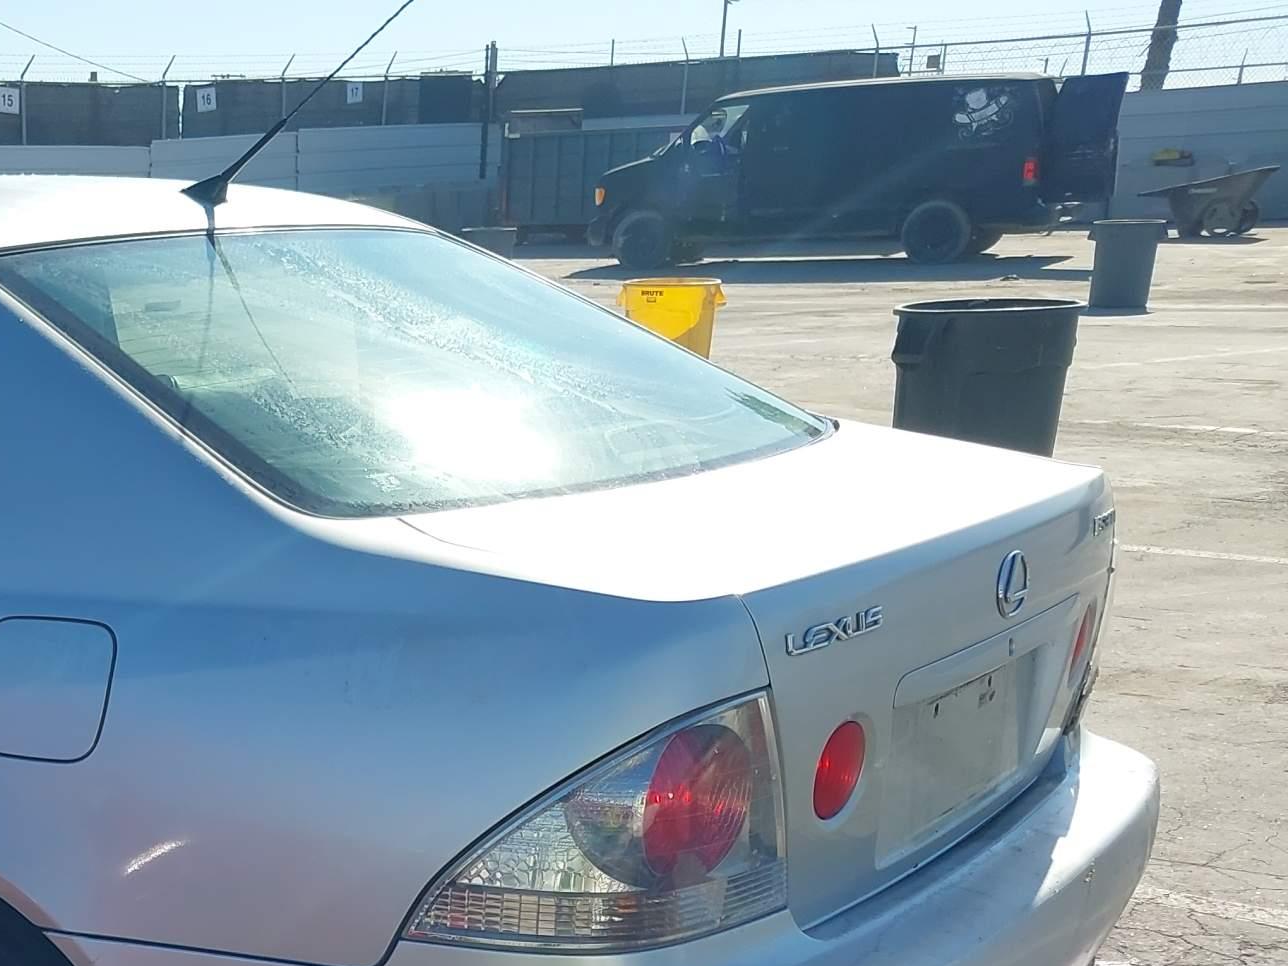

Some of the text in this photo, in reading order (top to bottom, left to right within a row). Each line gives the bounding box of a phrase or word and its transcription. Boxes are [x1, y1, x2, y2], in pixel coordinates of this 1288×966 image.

[351, 87, 359, 97] 17
[1, 93, 14, 108] 15
[201, 93, 212, 106] 16
[785, 605, 883, 656] LEXUS
